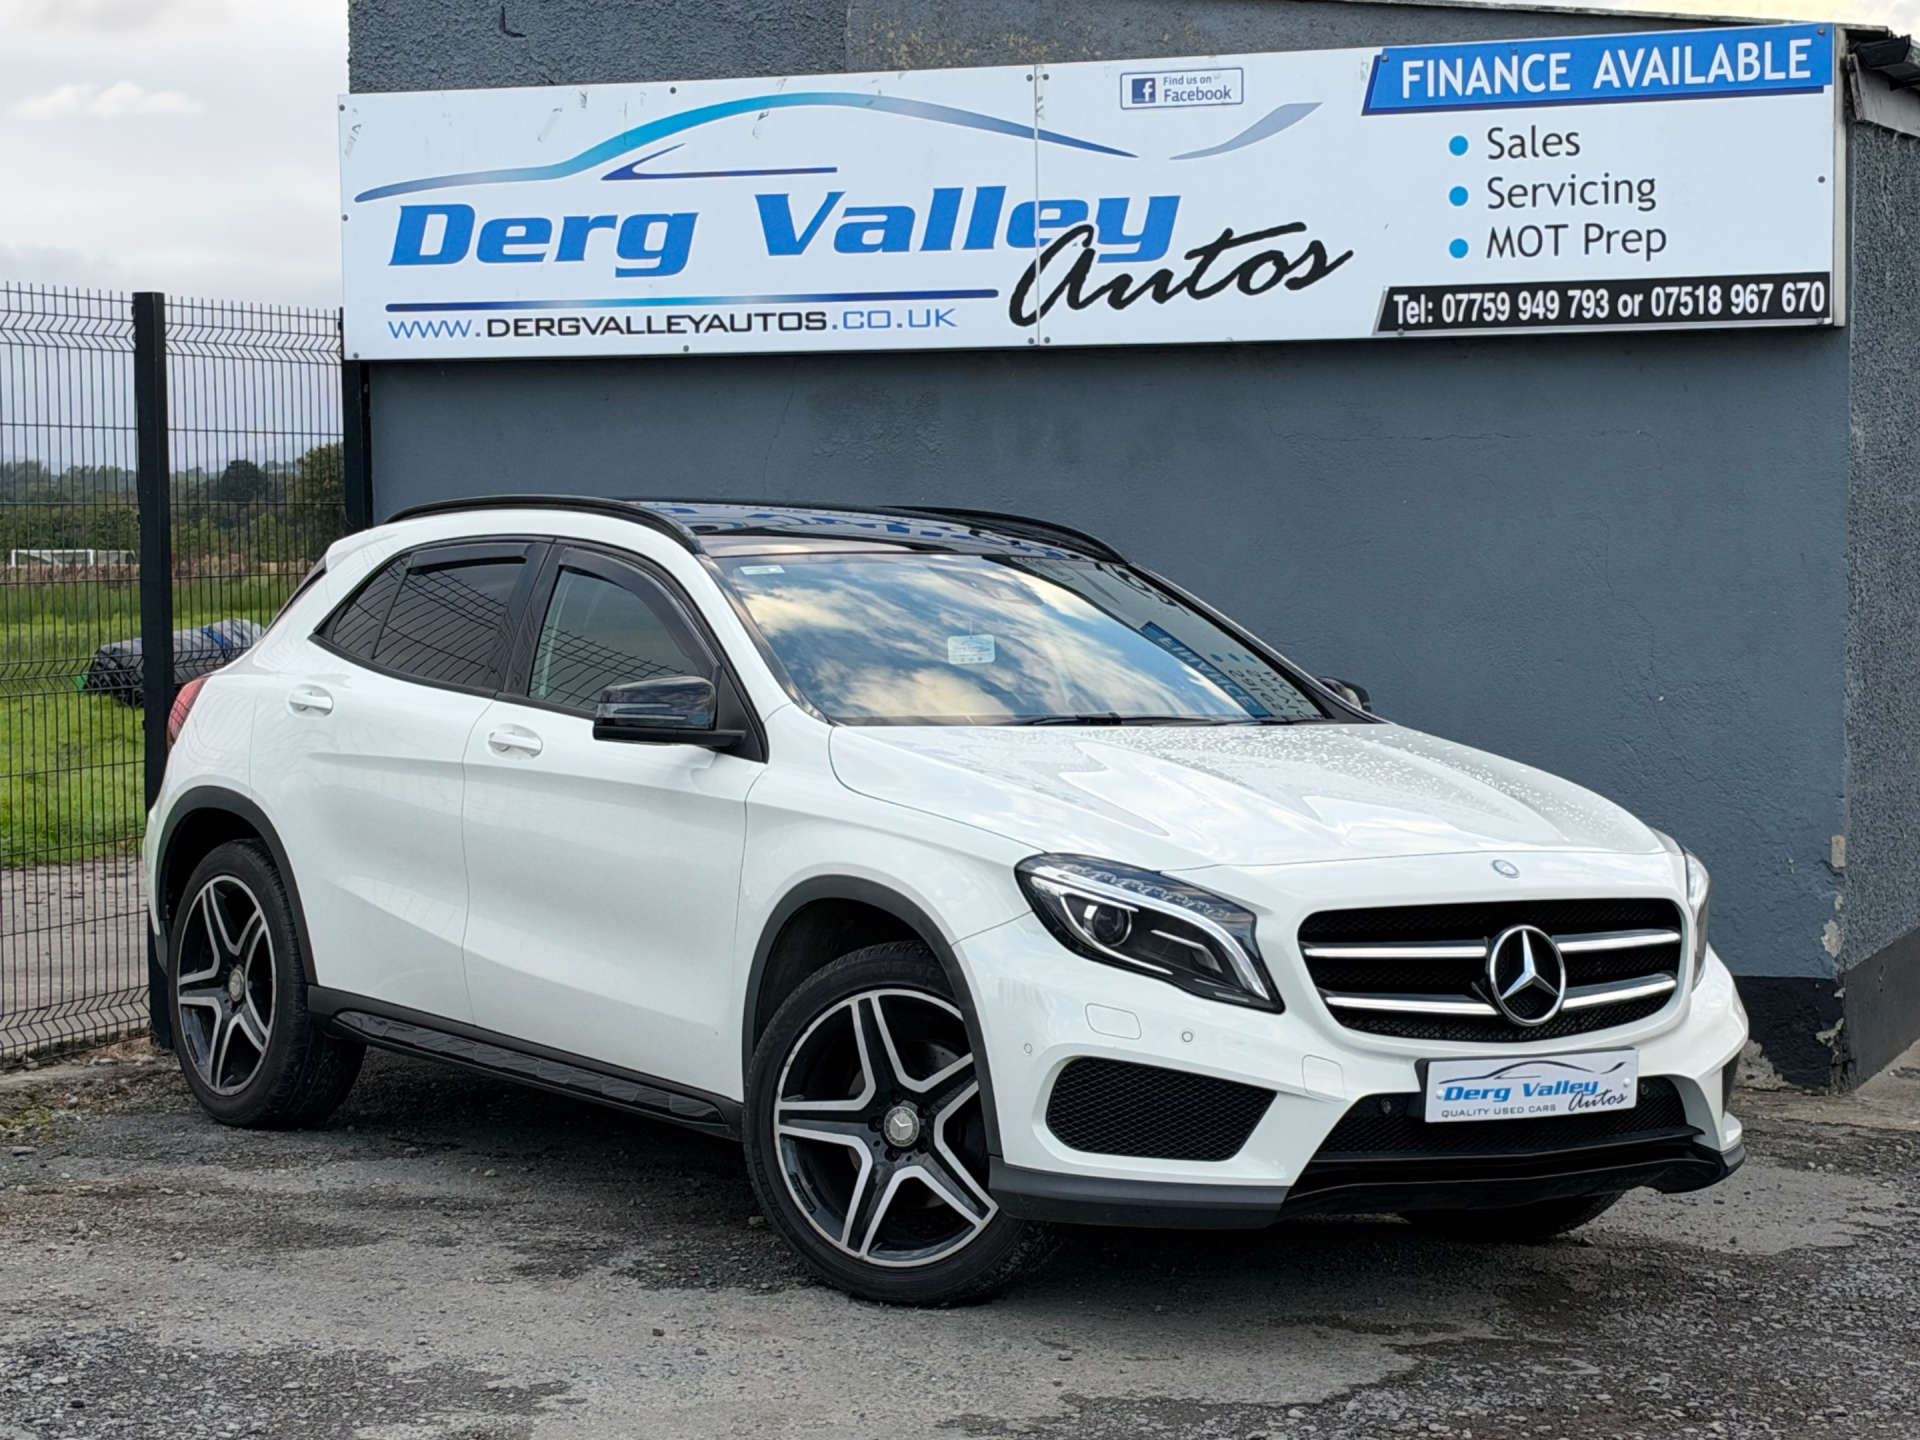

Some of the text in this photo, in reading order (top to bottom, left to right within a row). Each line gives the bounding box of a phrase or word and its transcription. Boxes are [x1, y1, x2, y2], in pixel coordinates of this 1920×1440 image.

[1163, 75, 1212, 86] Find us on
[1402, 39, 1812, 98] FINANCE AVAILABLE
[1164, 85, 1232, 102] Facebook
[1487, 125, 1581, 160] Sales
[1487, 173, 1656, 211] Servicing
[388, 185, 1181, 278] Derg Valley
[1486, 223, 1667, 261] MOT Prep
[1009, 222, 1353, 327] Autos
[1394, 281, 1825, 324] Tel: 07759 949 793 or 07518 967 670
[1443, 1080, 1598, 1102] Derg Valley
[1568, 1089, 1627, 1112] Autos
[1441, 1104, 1556, 1118] QUALITY USED CARS
